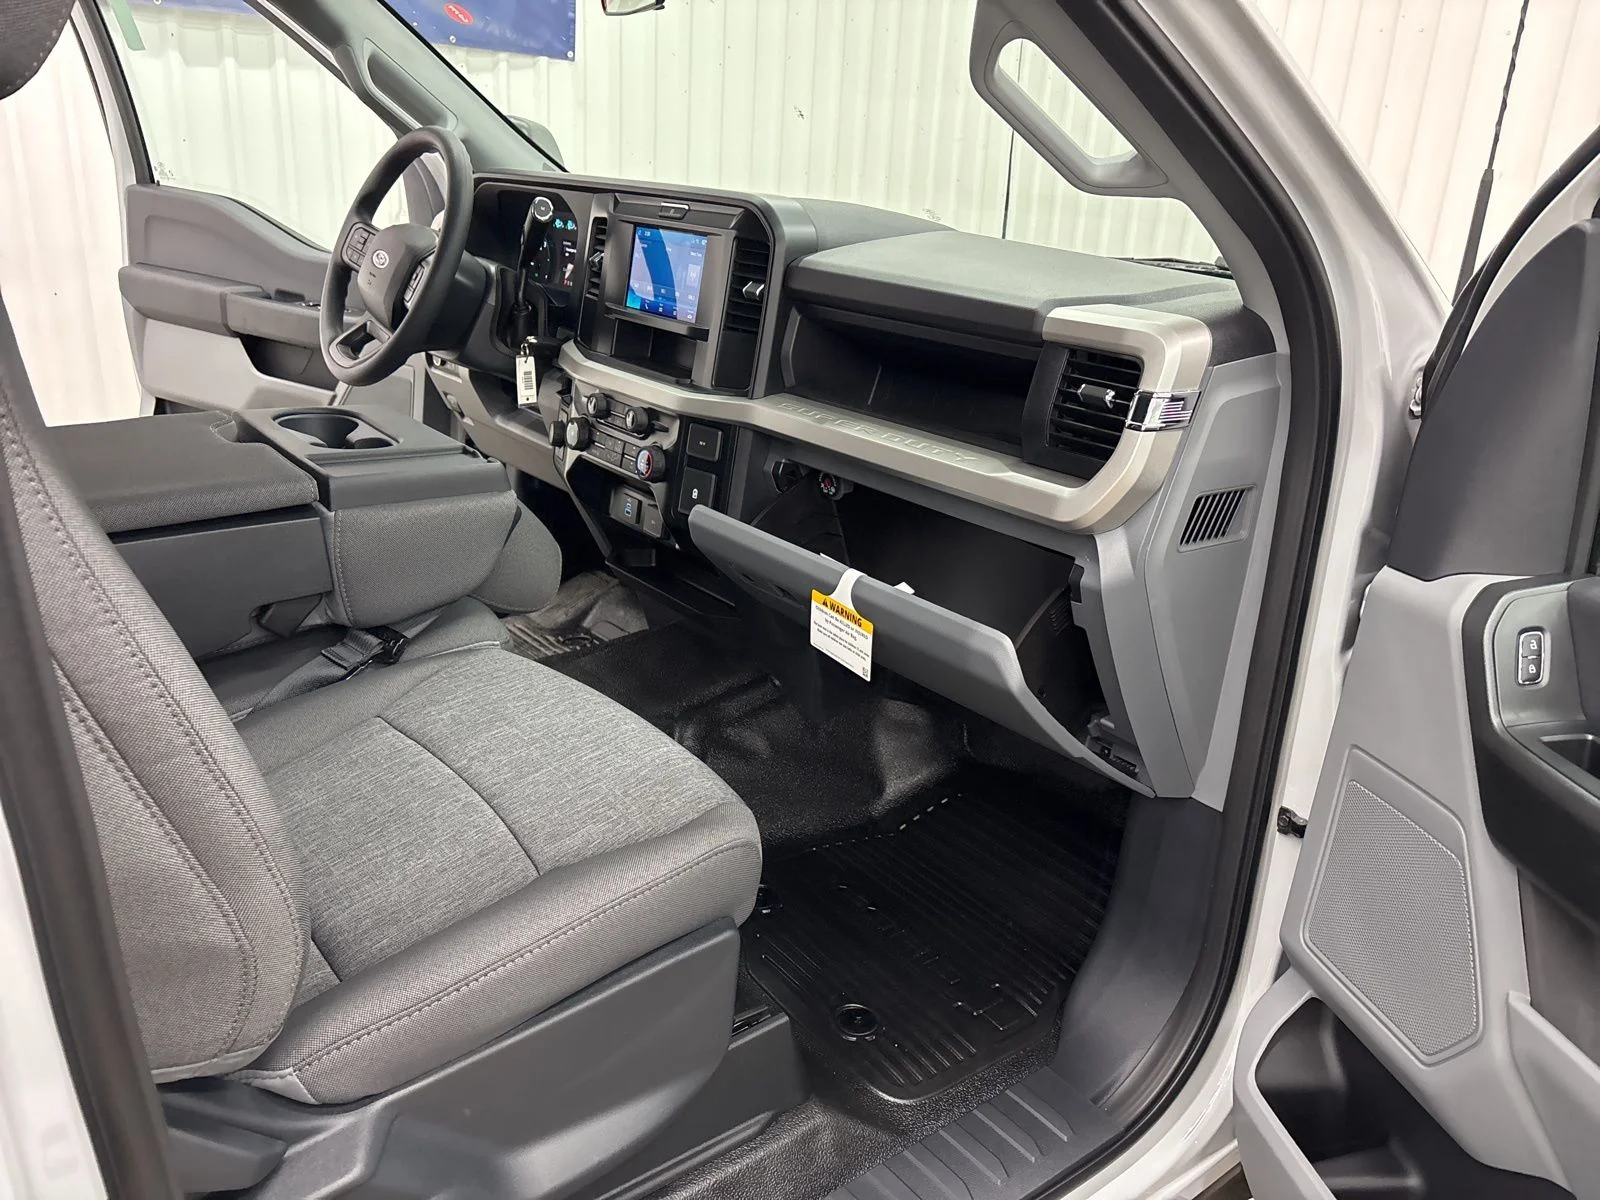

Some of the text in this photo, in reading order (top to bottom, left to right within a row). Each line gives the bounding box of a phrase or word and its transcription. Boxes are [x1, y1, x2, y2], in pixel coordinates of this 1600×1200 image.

[778, 402, 978, 464] SUPER DUTY
[830, 600, 862, 628] WARNING
